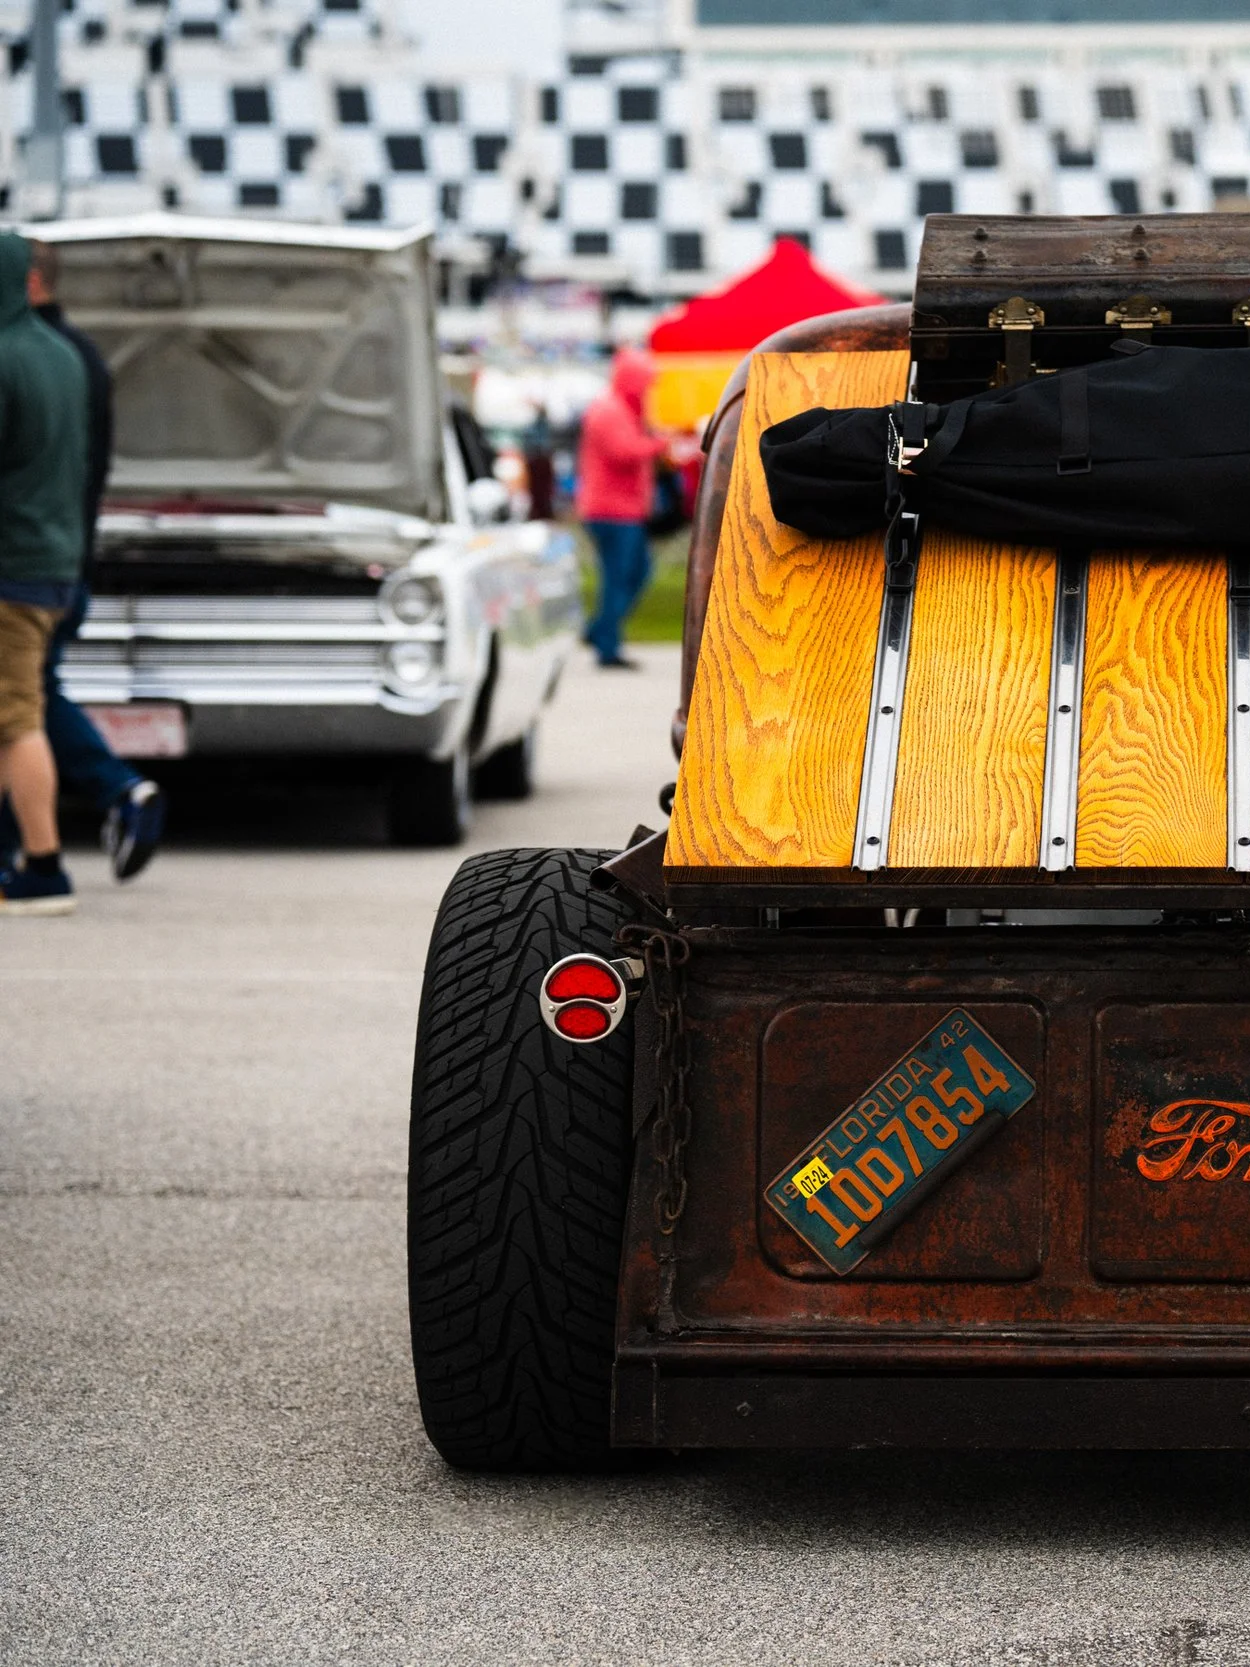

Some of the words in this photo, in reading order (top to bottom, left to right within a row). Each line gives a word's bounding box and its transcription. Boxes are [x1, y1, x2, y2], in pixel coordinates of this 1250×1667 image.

[774, 1183, 800, 1207] 19
[940, 1020, 969, 1049] 42
[799, 1165, 830, 1195] 07-24
[806, 1044, 1012, 1249] 10D7854
